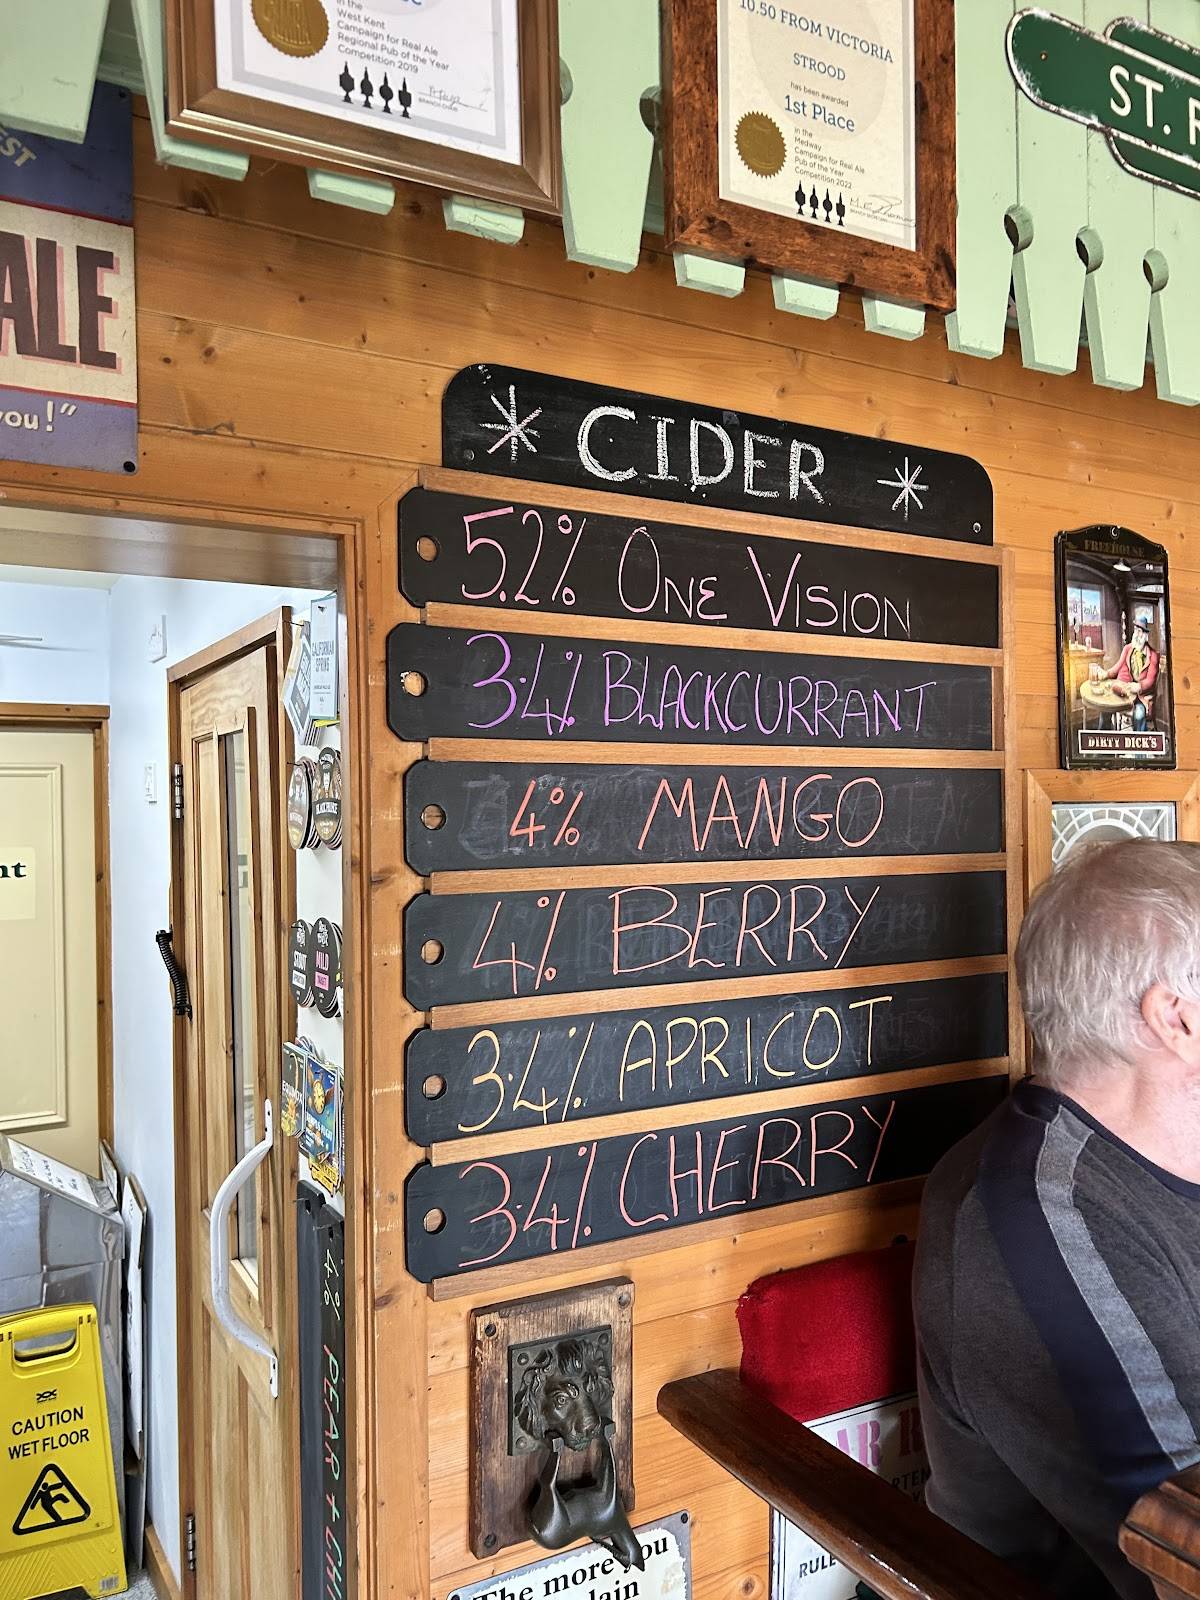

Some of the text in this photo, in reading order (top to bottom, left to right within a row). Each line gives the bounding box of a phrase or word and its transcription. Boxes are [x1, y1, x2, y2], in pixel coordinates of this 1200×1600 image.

[337, 8, 386, 30] West Kent
[337, 20, 439, 57] Campaign for Real Ale
[739, 0, 894, 64] 10.50 FROM VICTORIA
[337, 32, 450, 71] Regional Pub of the Year
[337, 44, 419, 74] Competition 2019
[793, 52, 846, 81] STROOD
[784, 94, 855, 133] 1st Place
[790, 81, 849, 108] has been awarded
[1109, 64, 1171, 135] ST.
[0, 127, 37, 167] ST
[794, 136, 822, 151] Medway
[802, 128, 813, 138] the
[794, 146, 865, 174] Campaign for Real Ale
[794, 156, 808, 166] Pub
[817, 163, 828, 173] the
[829, 167, 844, 177] Year
[794, 166, 835, 185] Competition
[576, 405, 828, 506] CIDER
[461, 507, 586, 607] 5.2%
[602, 650, 937, 740] BLACKCURRANT
[1087, 734, 1158, 749] DIRTY DICK'S
[508, 773, 884, 851] 4% MANGO
[472, 884, 880, 995] 4% BERRY
[315, 949, 330, 972] MILD
[619, 996, 893, 1101] APRICOT
[618, 1100, 896, 1227] CHERRY
[323, 1249, 341, 1320] 4%
[11, 1405, 84, 1437] CAUTION
[323, 1344, 340, 1481] PEAR
[8, 1428, 90, 1460] WET FLOOR
[543, 1559, 615, 1598] more
